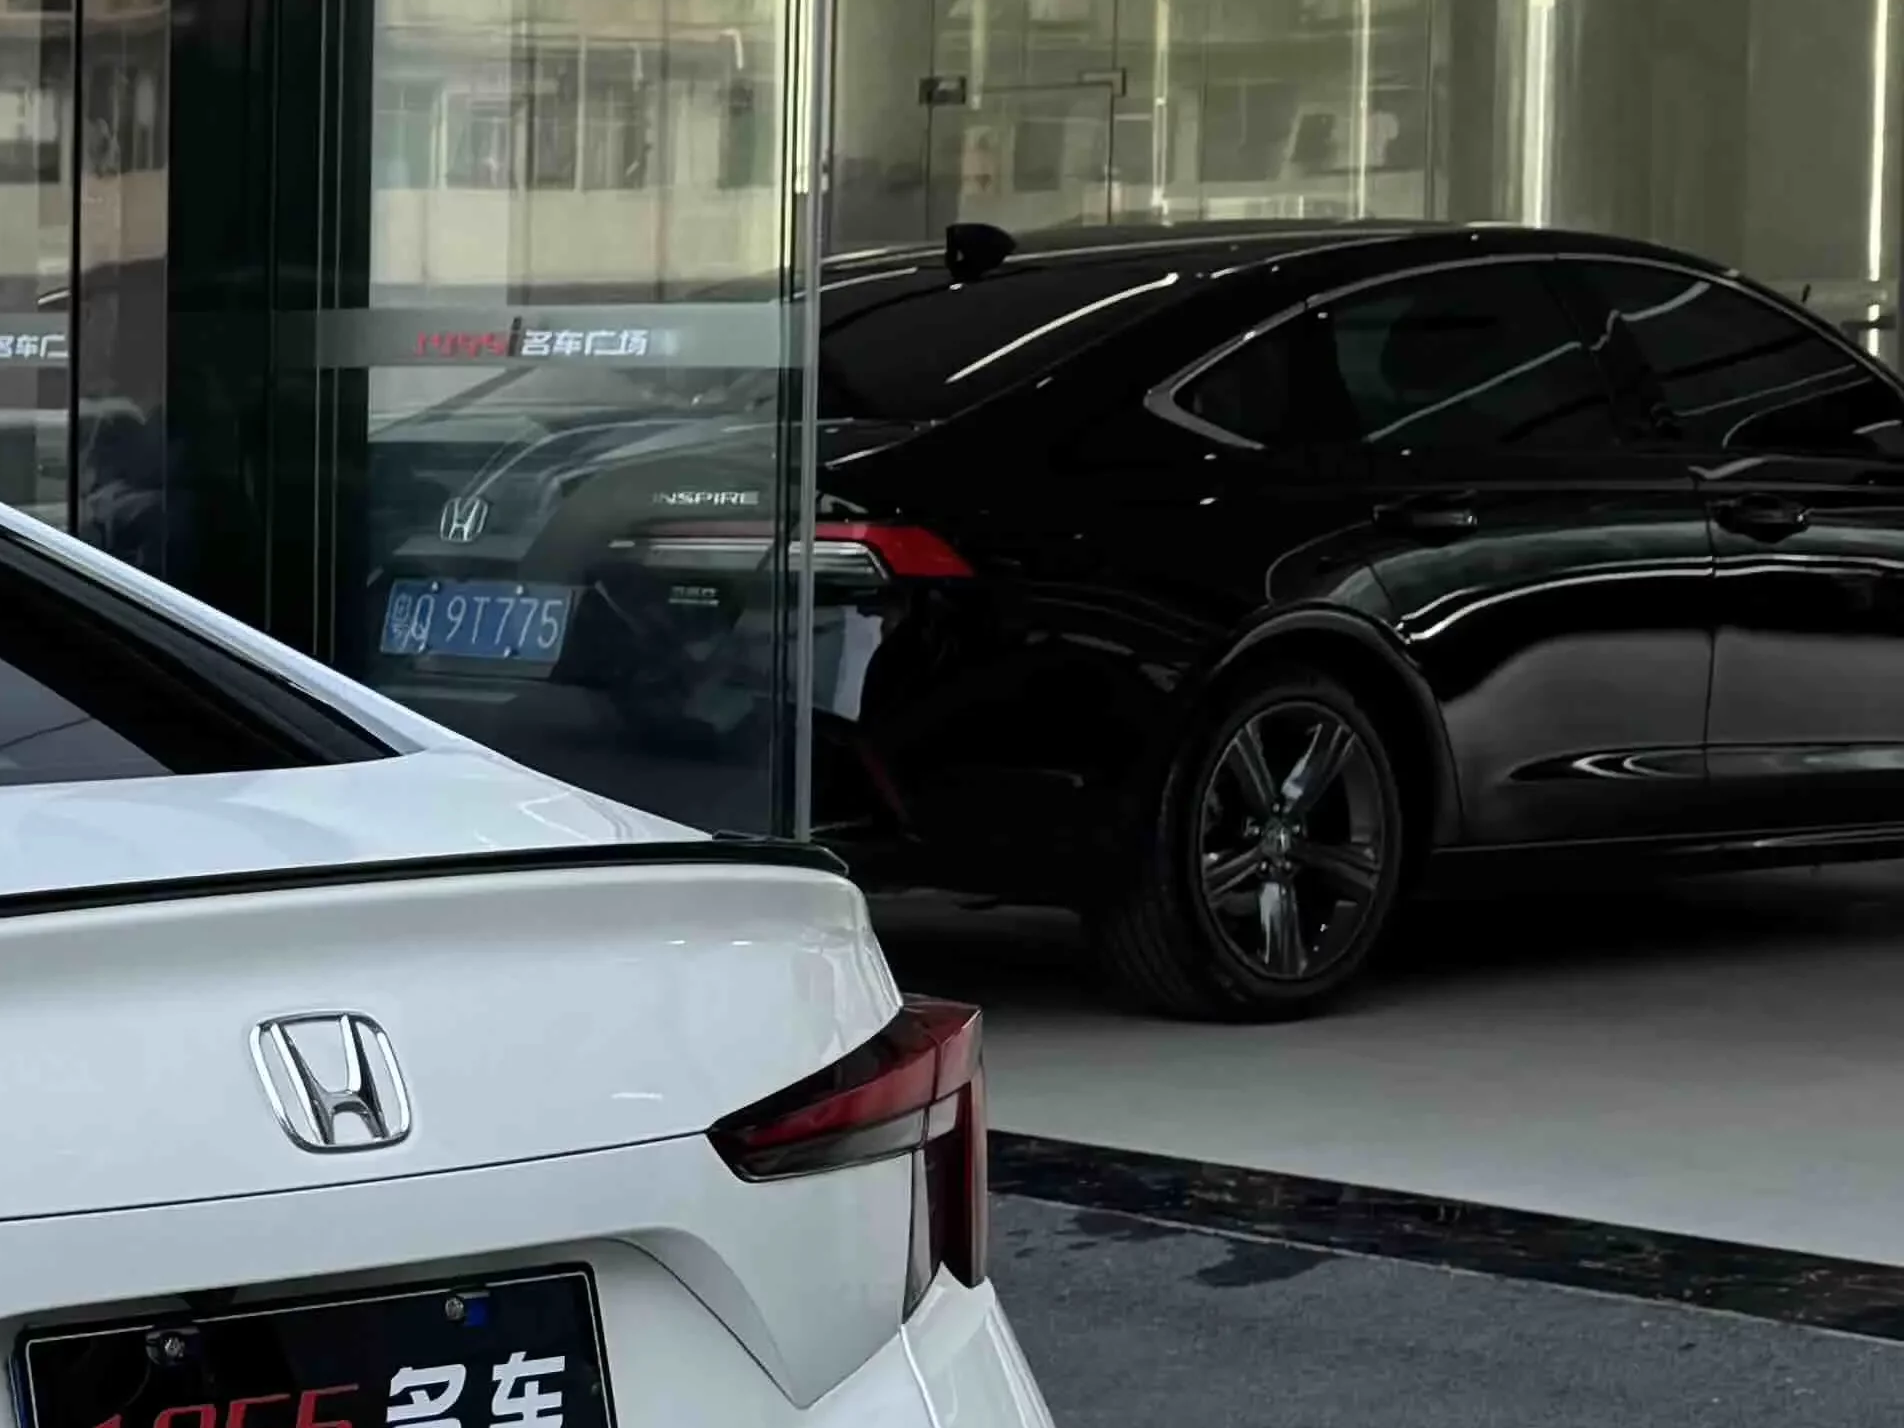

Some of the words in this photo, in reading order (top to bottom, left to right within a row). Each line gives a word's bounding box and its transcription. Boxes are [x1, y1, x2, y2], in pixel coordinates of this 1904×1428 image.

[521, 329, 649, 357] 名车广场
[653, 491, 759, 505] INSPIRE
